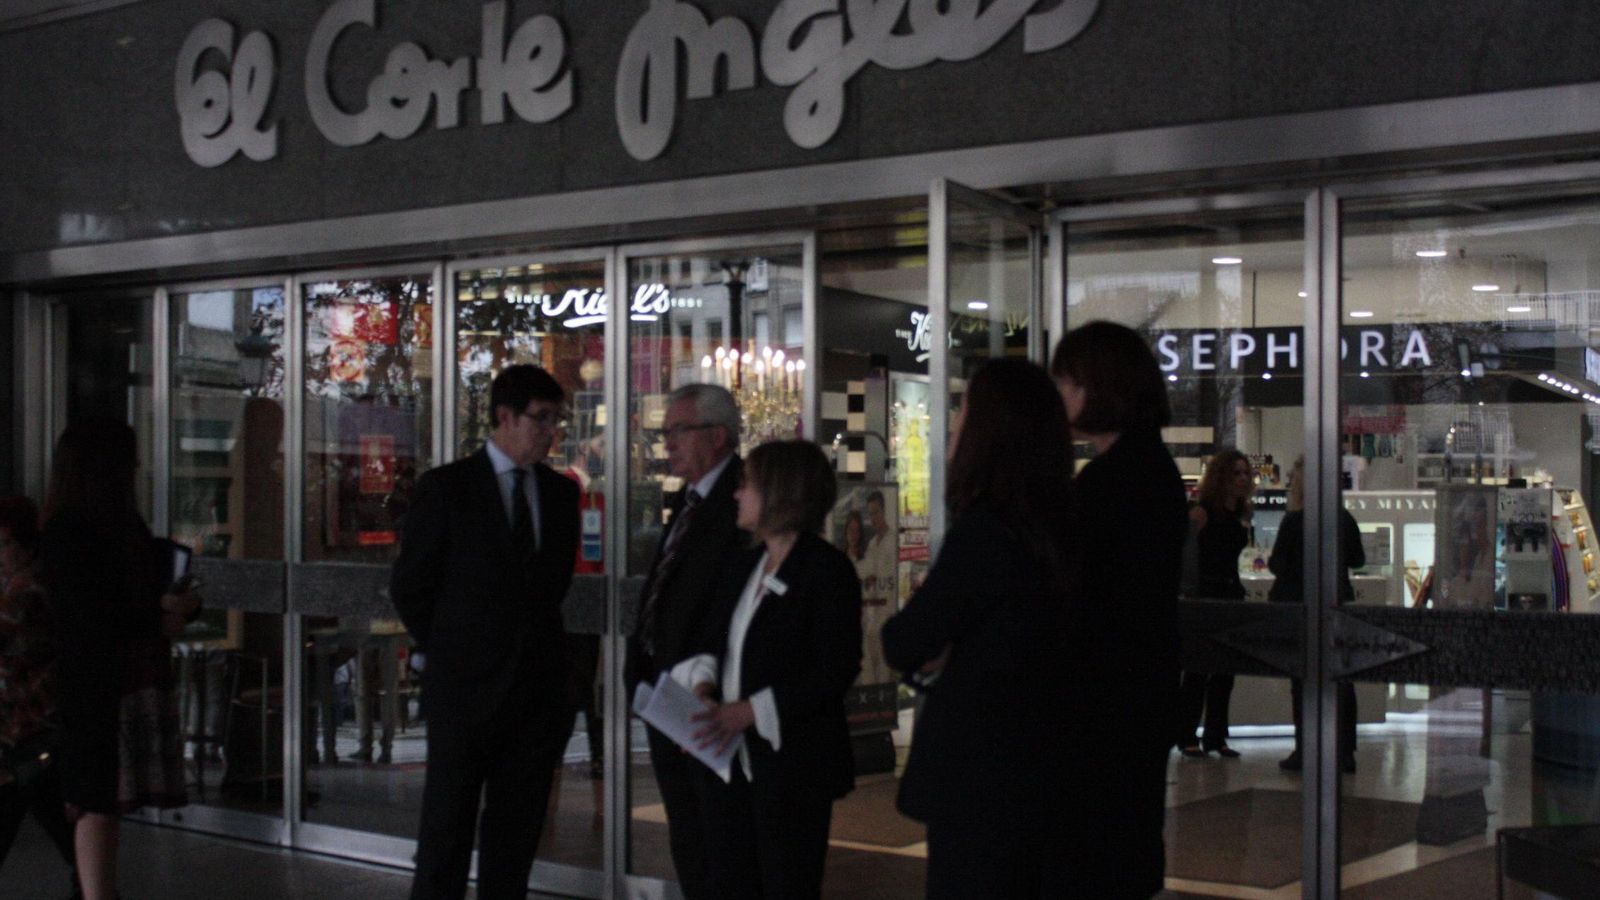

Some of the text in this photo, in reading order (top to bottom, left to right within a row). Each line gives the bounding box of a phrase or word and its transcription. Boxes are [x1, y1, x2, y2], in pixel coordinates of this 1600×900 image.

[175, 18, 278, 167] El
[304, 0, 574, 147] Corte
[541, 283, 671, 319] Kiel's
[1158, 330, 1432, 371] SEPHRA
